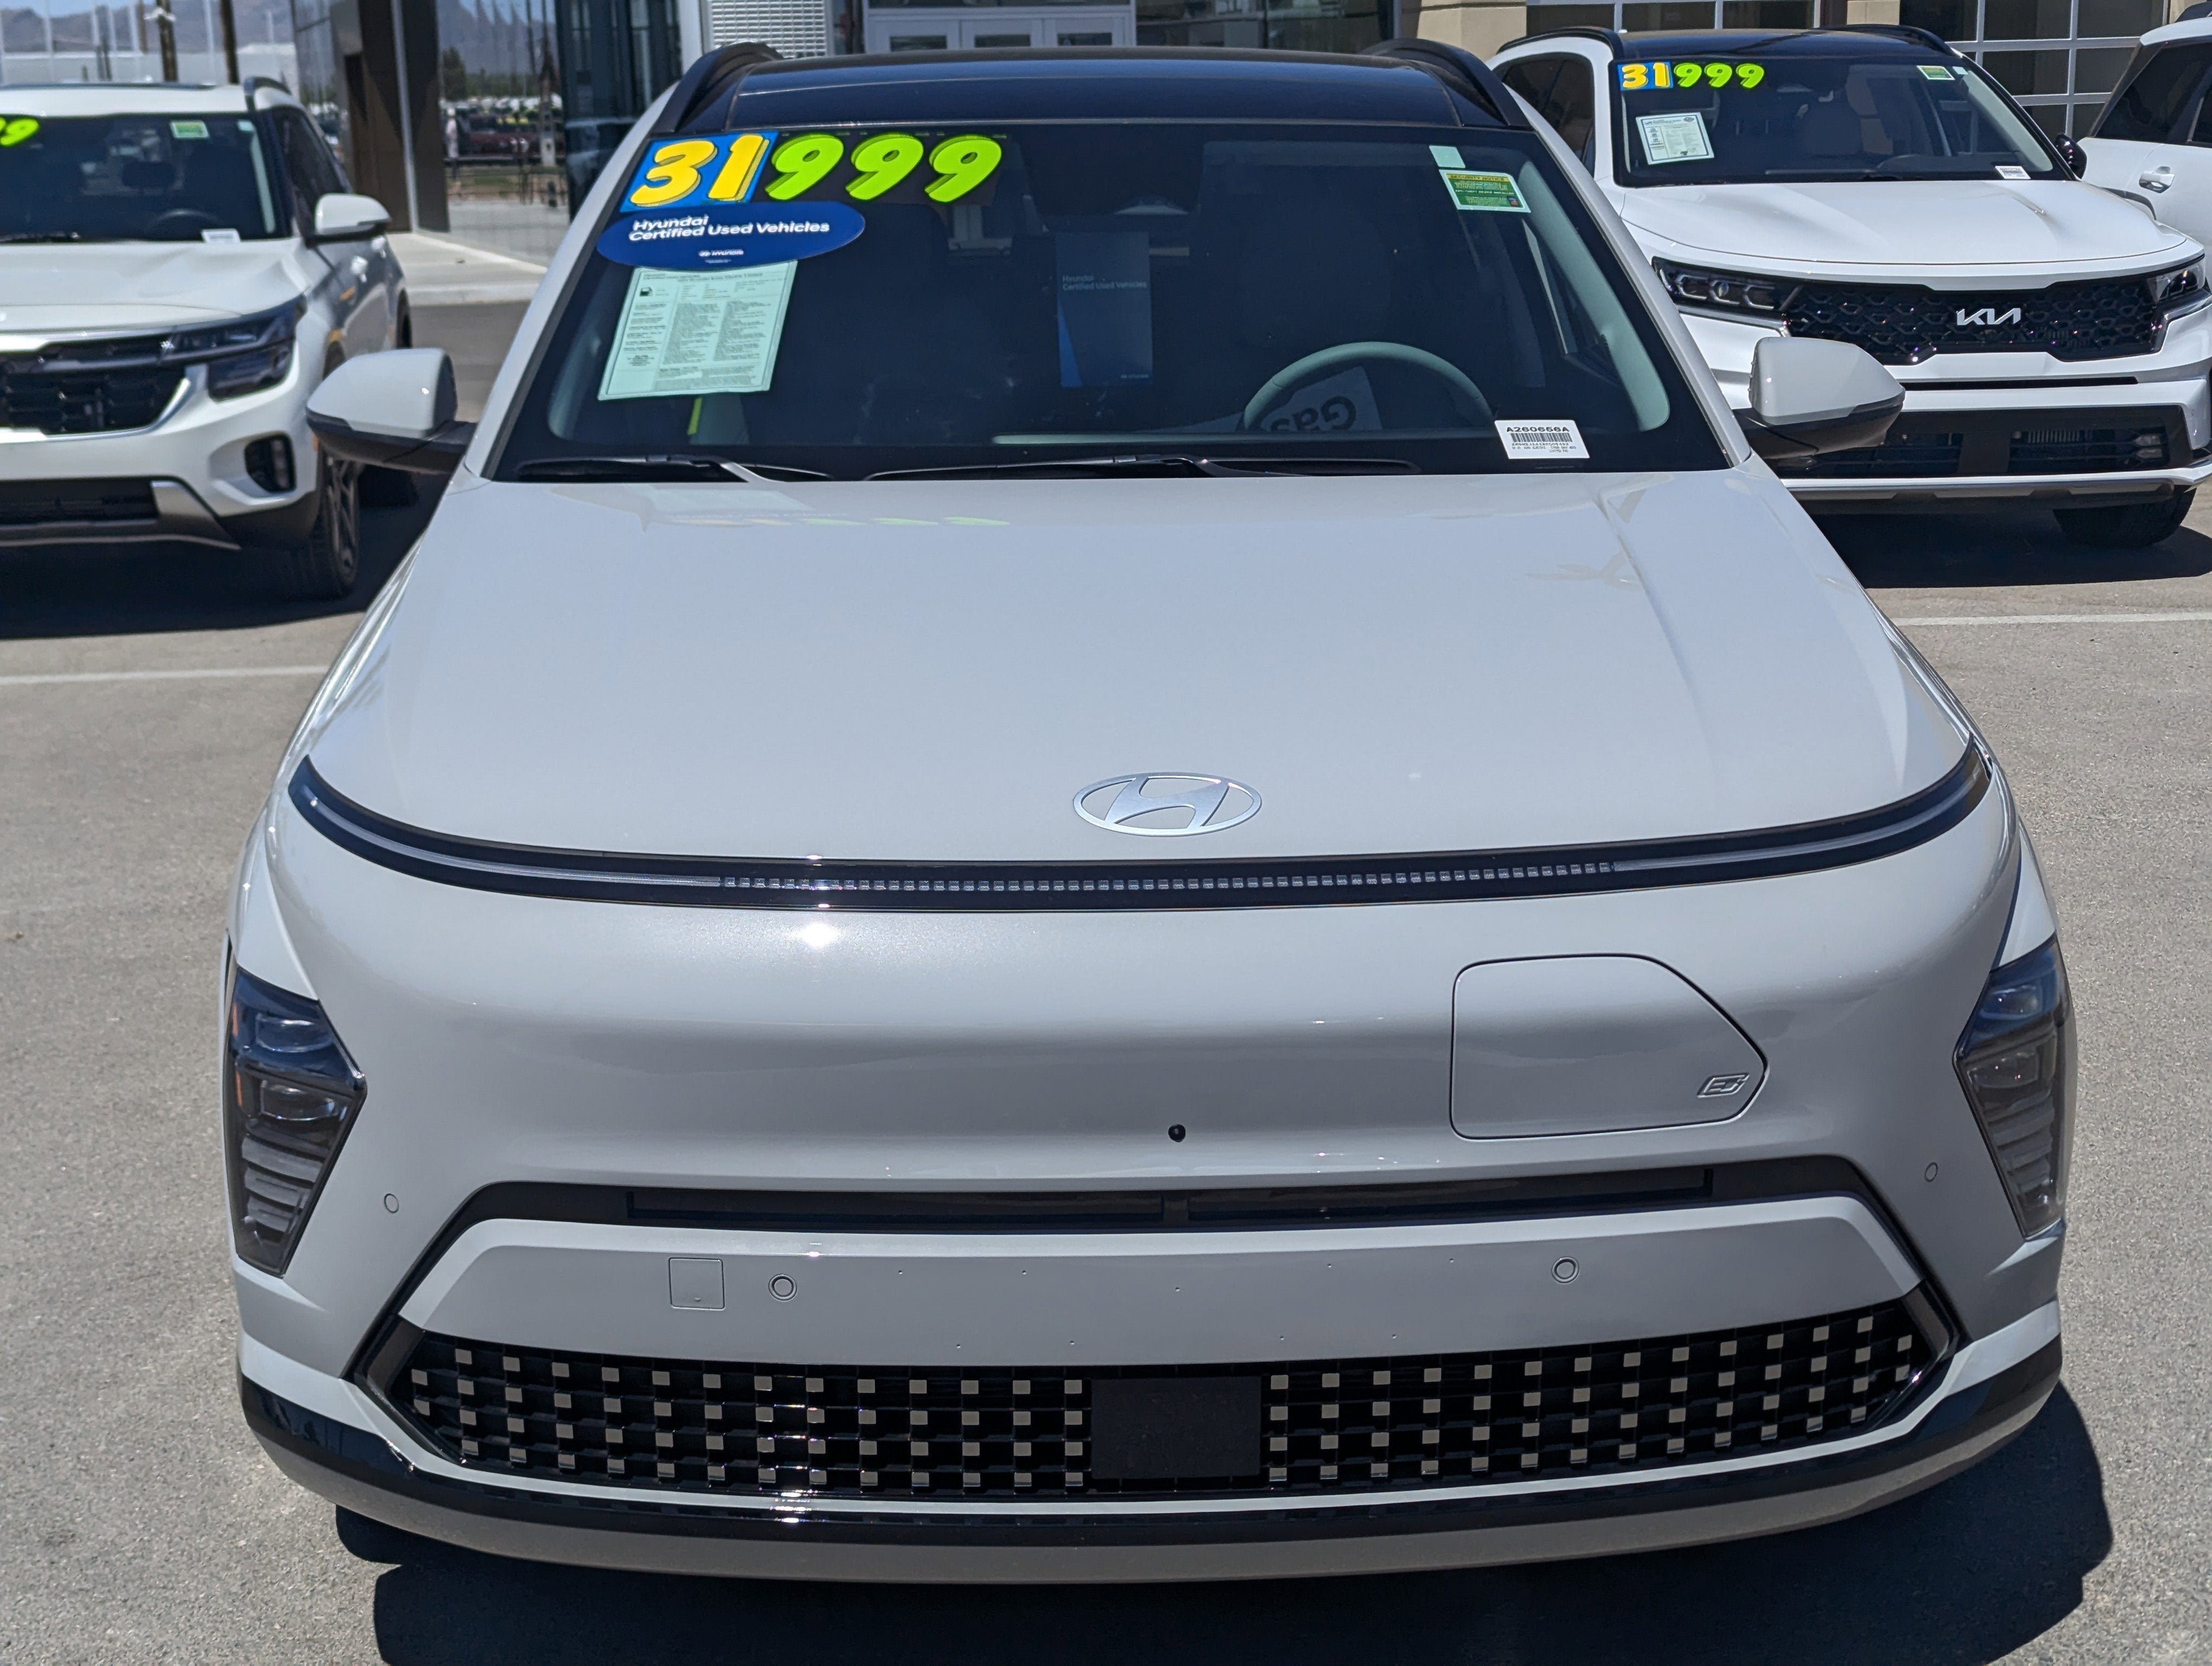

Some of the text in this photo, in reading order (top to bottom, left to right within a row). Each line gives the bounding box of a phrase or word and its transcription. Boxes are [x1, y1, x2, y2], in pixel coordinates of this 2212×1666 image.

[0, 116, 40, 147] 9
[629, 221, 830, 241] Certified Used Vehicles
[633, 214, 709, 230] Hyundai
[1957, 307, 2021, 325] KIA
